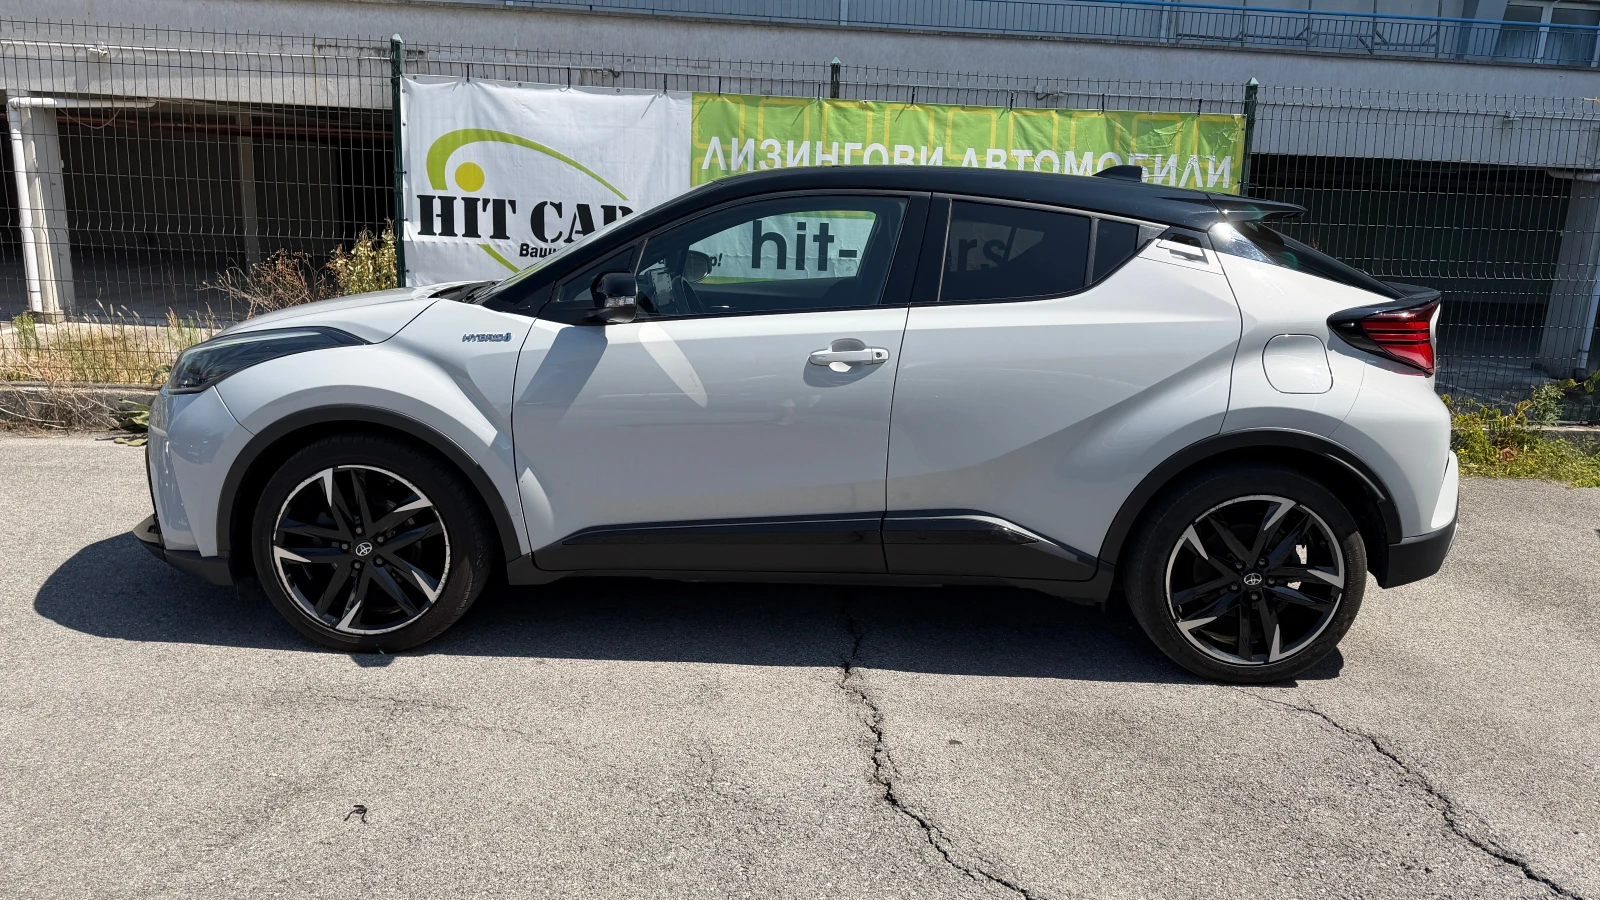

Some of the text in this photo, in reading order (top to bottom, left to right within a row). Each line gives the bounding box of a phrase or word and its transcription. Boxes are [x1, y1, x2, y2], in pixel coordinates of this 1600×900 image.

[702, 136, 943, 171] ЛИЗИНГОВИ
[416, 194, 517, 240] HIT
[751, 219, 1008, 273] hit- rs
